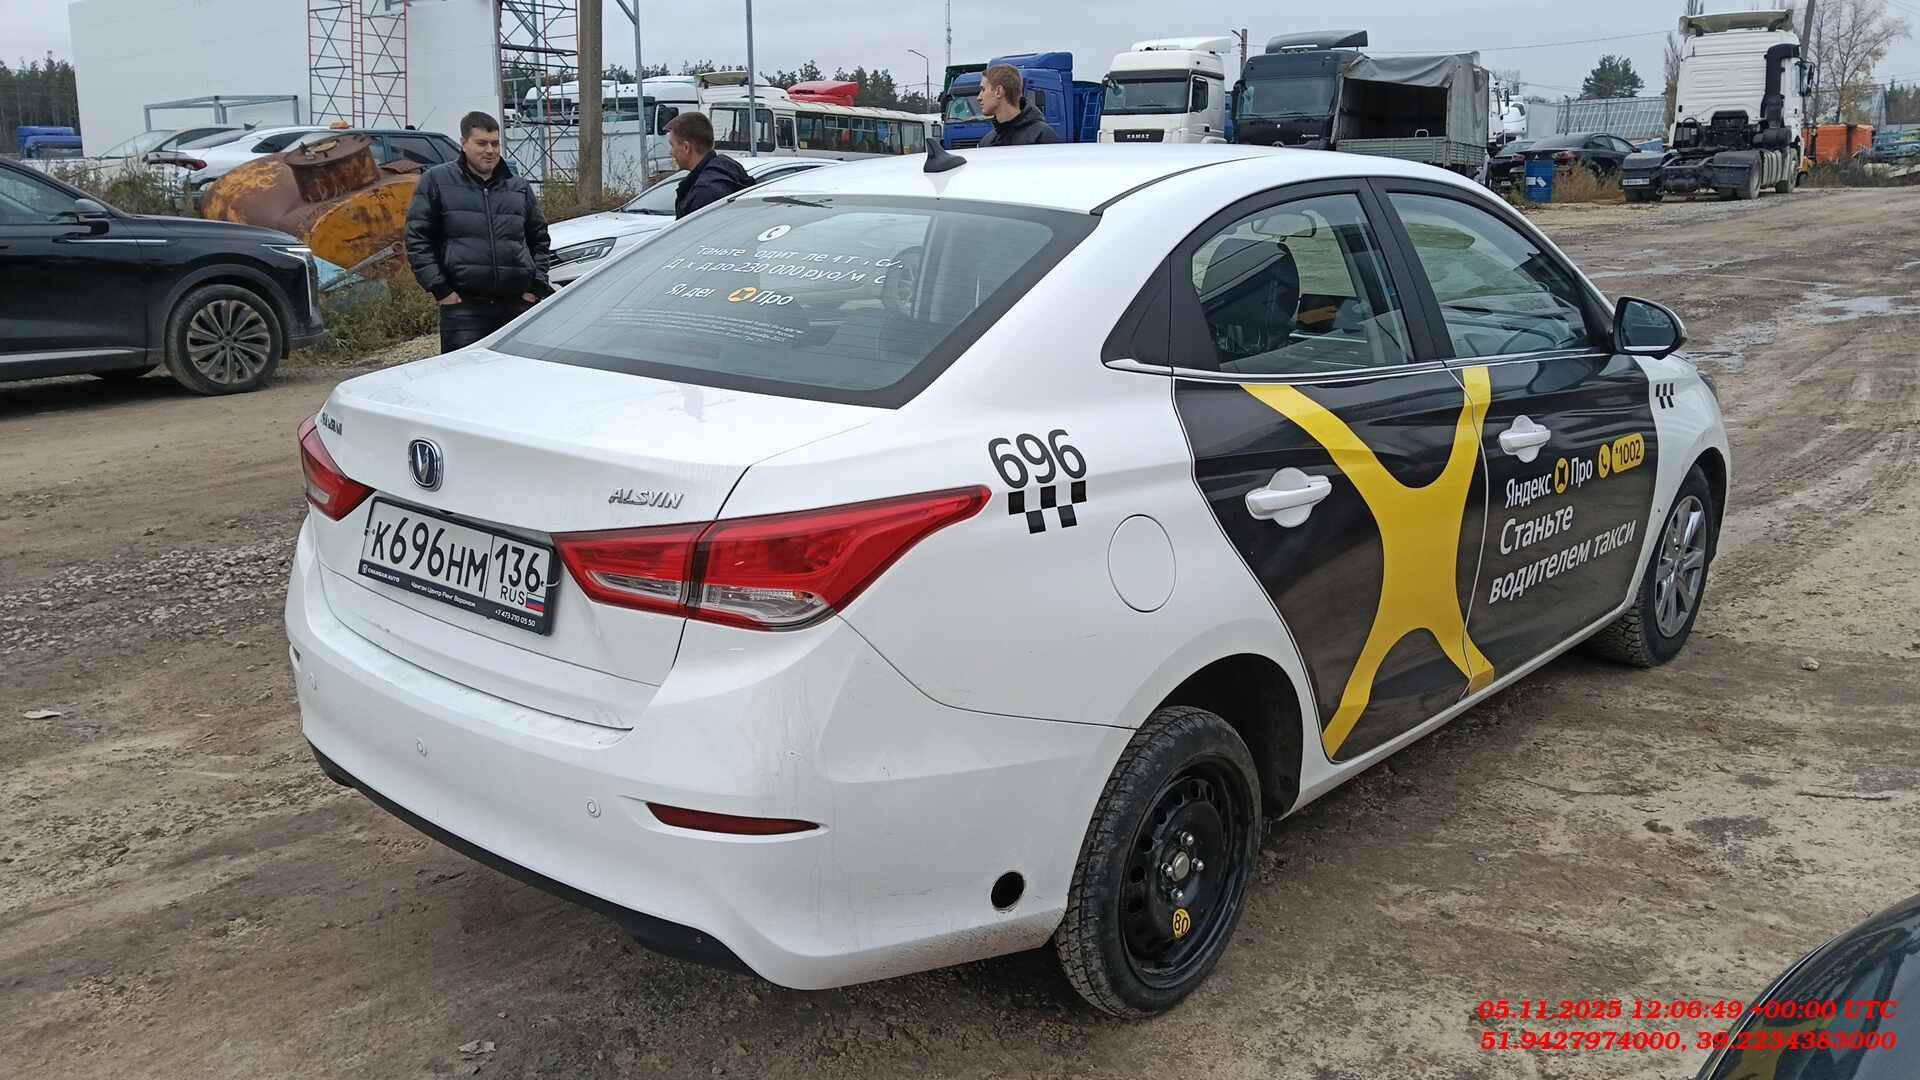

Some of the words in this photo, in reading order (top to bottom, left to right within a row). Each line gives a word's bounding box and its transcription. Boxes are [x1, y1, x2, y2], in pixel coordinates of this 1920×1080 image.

[750, 290, 794, 306] Про
[988, 428, 1087, 489] 696
[1504, 473, 1552, 509] Яндекс
[1570, 457, 1593, 489] Про
[608, 488, 684, 509] ALSVIN
[1500, 505, 1574, 555] Станьте
[494, 543, 541, 593] 136
[1488, 539, 1591, 605] водителем
[1593, 519, 1637, 558] такси
[500, 585, 526, 605] RUS
[1174, 912, 1189, 934] 80
